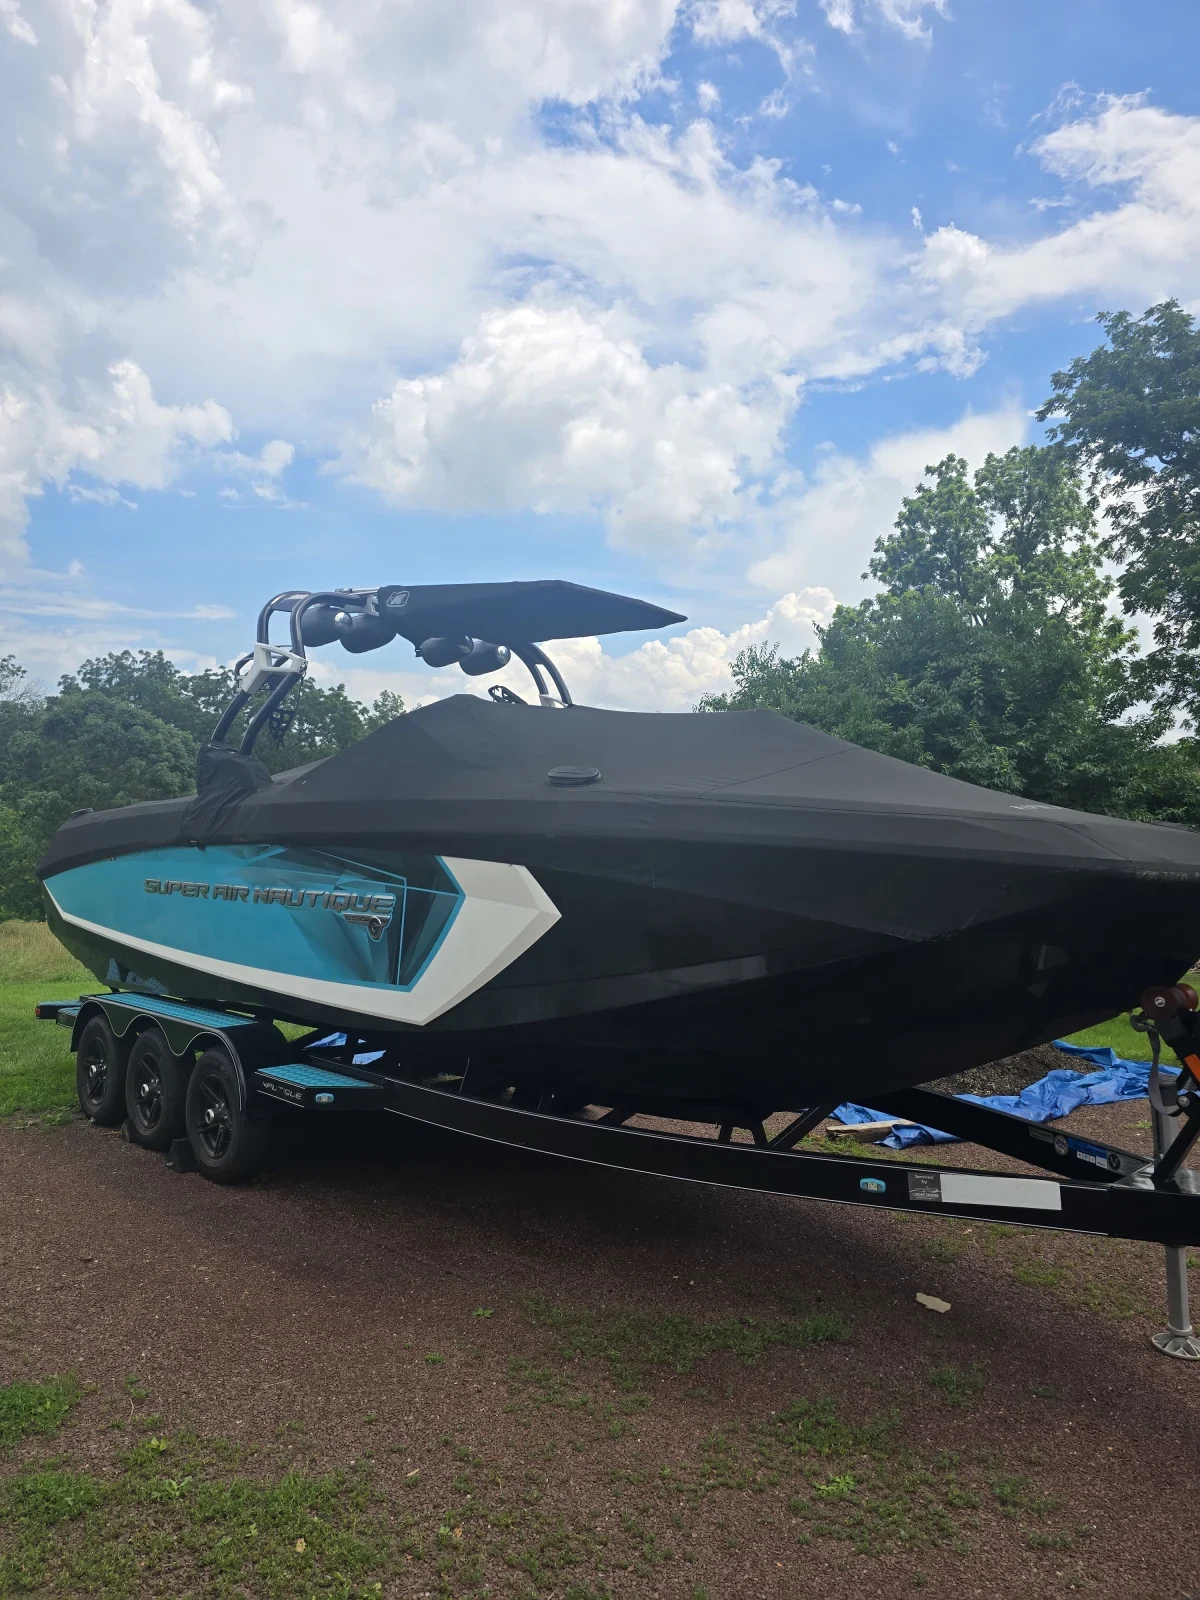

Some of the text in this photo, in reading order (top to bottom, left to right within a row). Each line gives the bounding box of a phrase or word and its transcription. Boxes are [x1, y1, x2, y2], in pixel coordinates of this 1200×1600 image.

[144, 878, 395, 914] SUPER AIR NAUTIQUE
